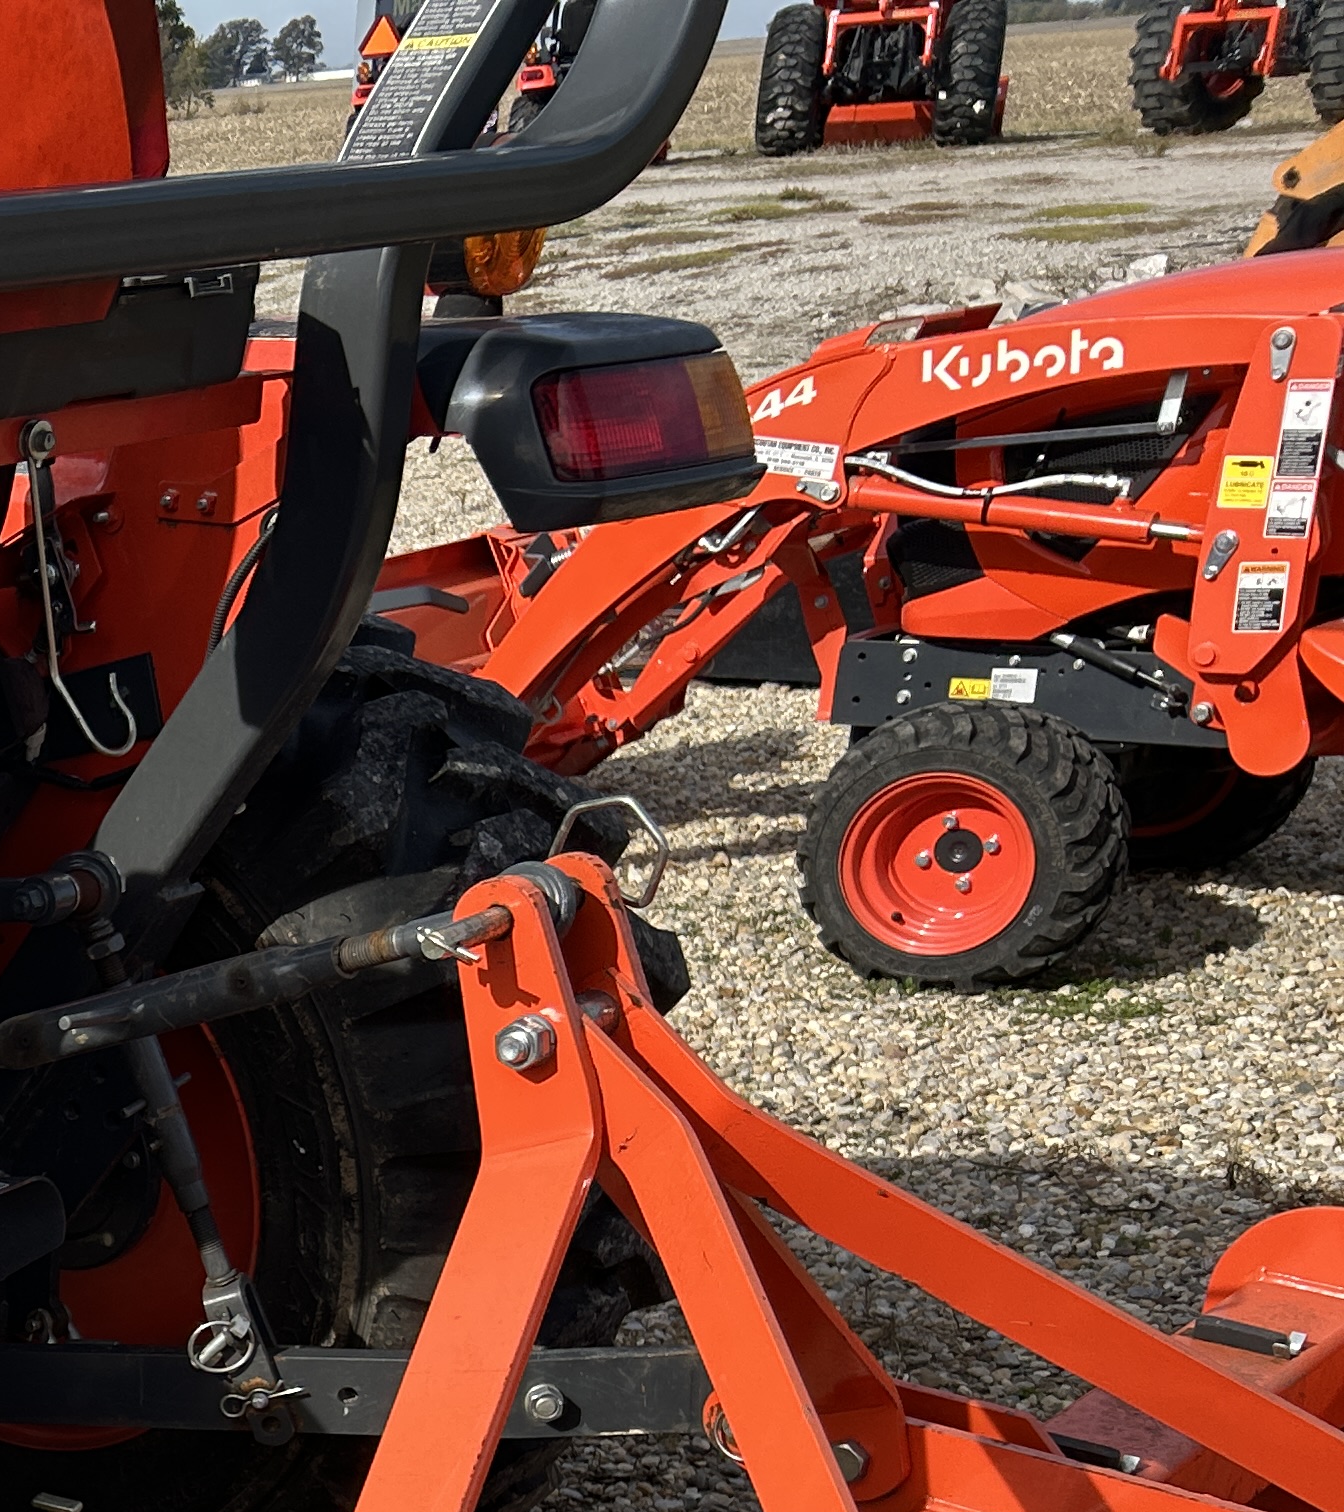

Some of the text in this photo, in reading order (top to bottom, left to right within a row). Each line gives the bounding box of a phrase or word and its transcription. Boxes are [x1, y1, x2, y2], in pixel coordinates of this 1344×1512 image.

[418, 36, 472, 48] CAUTION
[921, 328, 1124, 391] Kubota
[1298, 382, 1331, 392] DANGER
[1281, 483, 1314, 492] DANGER
[1250, 565, 1286, 573] WARNING
